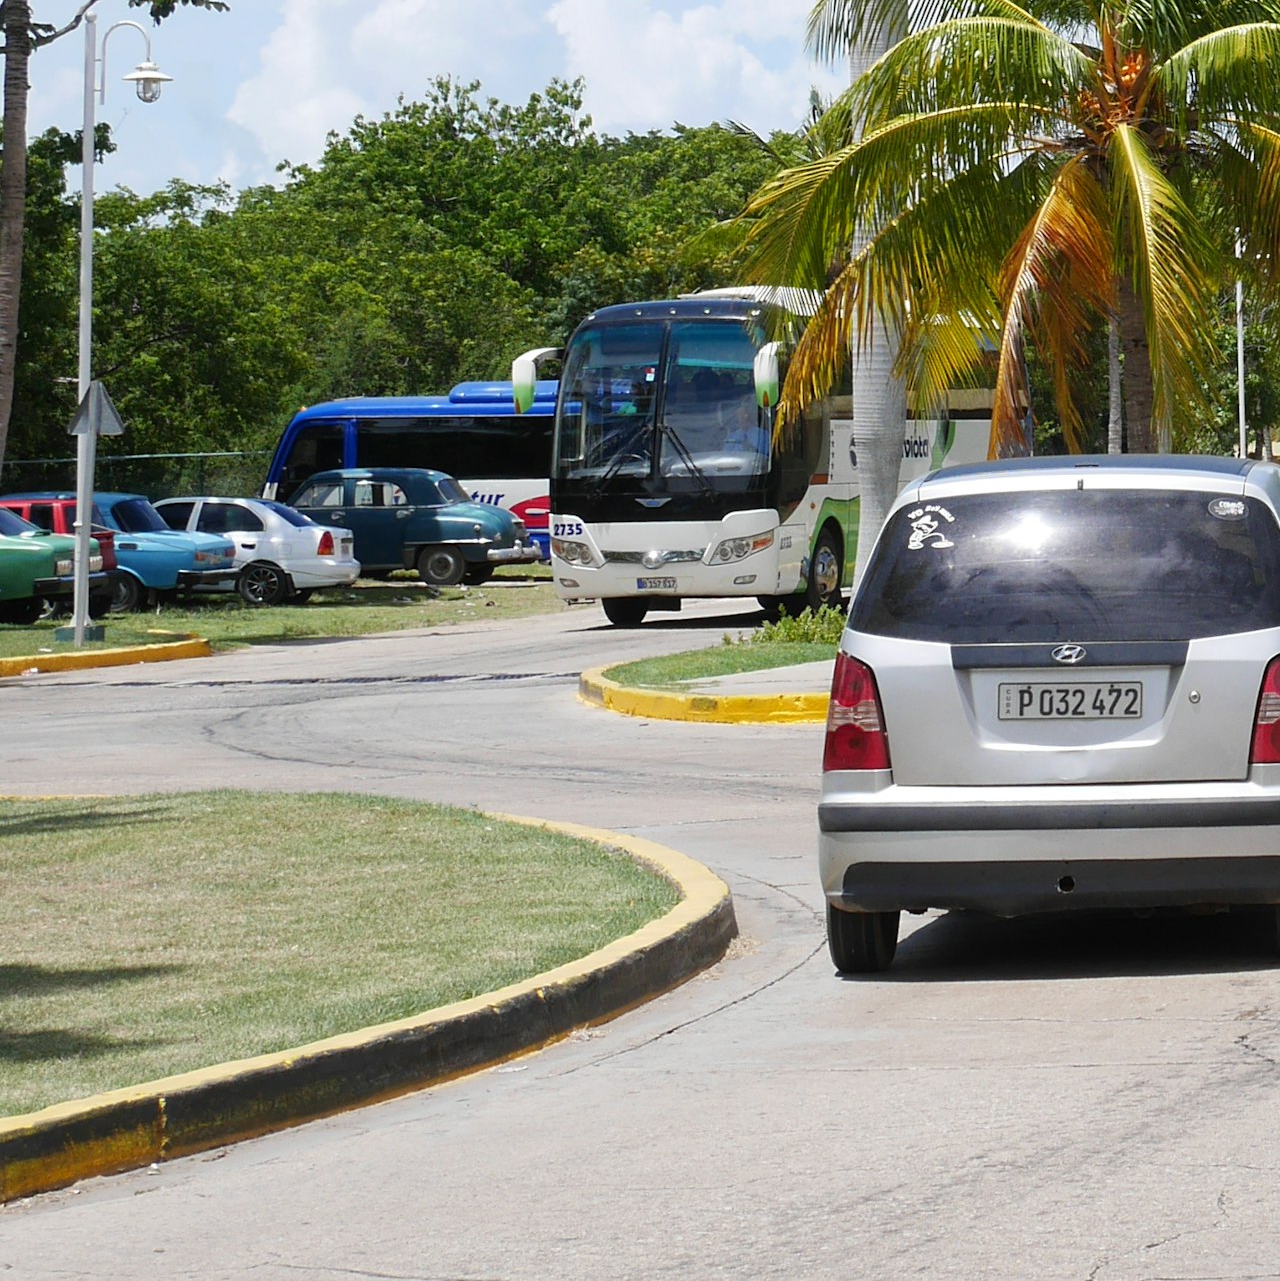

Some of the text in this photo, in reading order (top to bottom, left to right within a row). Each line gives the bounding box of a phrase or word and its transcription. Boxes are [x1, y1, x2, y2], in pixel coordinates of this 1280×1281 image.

[902, 436, 929, 458] viota
[471, 490, 505, 506] tur
[553, 523, 583, 537] 2735
[1091, 687, 1139, 716] 472
